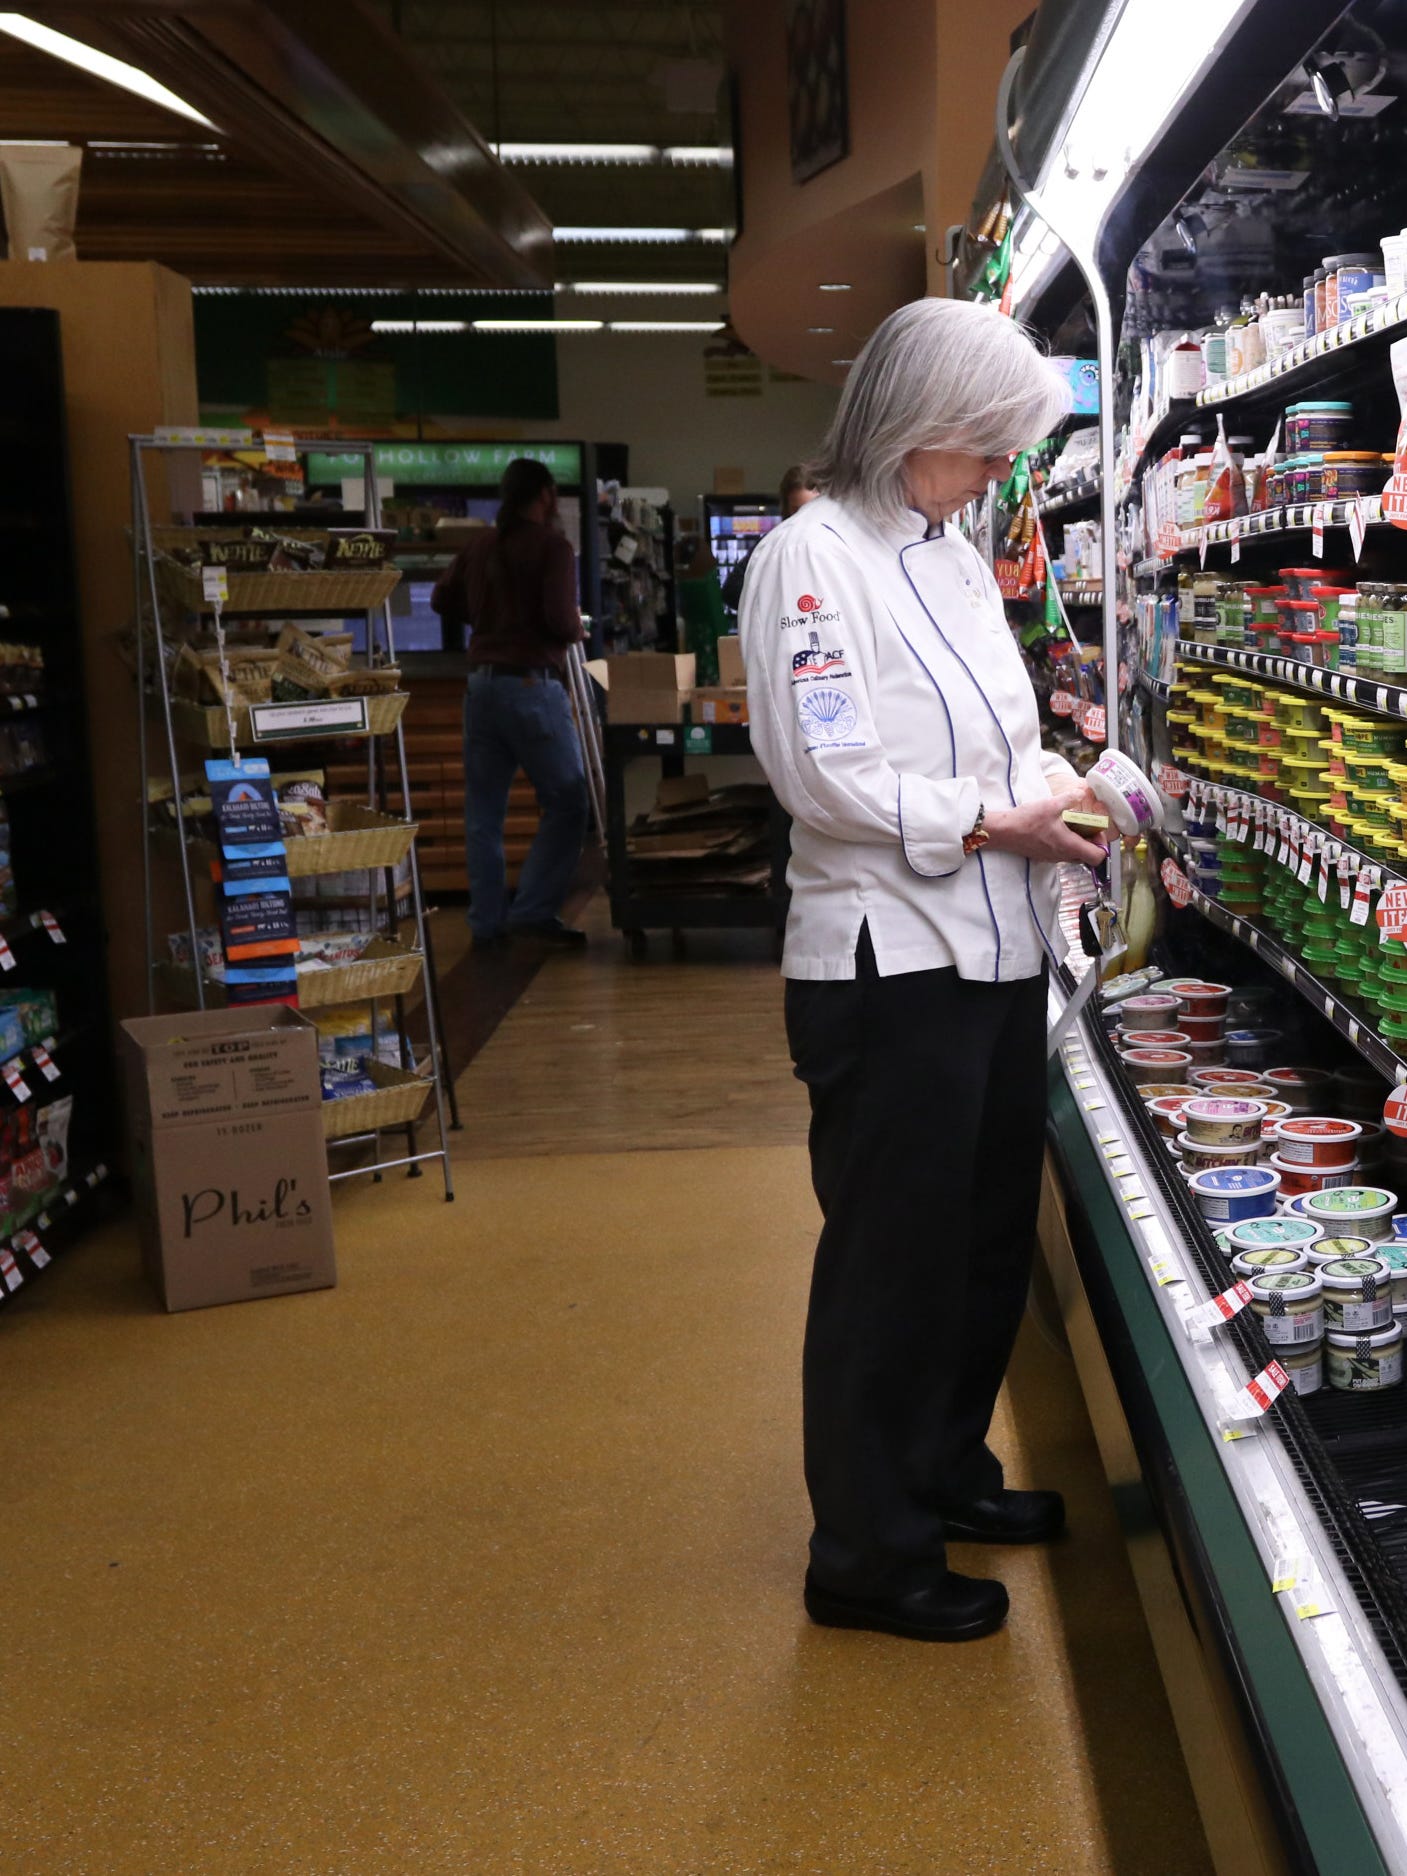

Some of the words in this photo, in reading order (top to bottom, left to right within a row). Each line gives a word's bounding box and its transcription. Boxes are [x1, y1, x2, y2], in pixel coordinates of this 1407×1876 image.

[378, 450, 482, 465] HOLLOW
[494, 450, 556, 465] FARM
[780, 616, 808, 630] Slow
[811, 611, 840, 624] Food
[825, 650, 845, 660] ACF
[201, 1057, 227, 1067] SAFETY
[233, 1123, 263, 1136] DOZEN
[181, 1178, 312, 1239] Phil's
